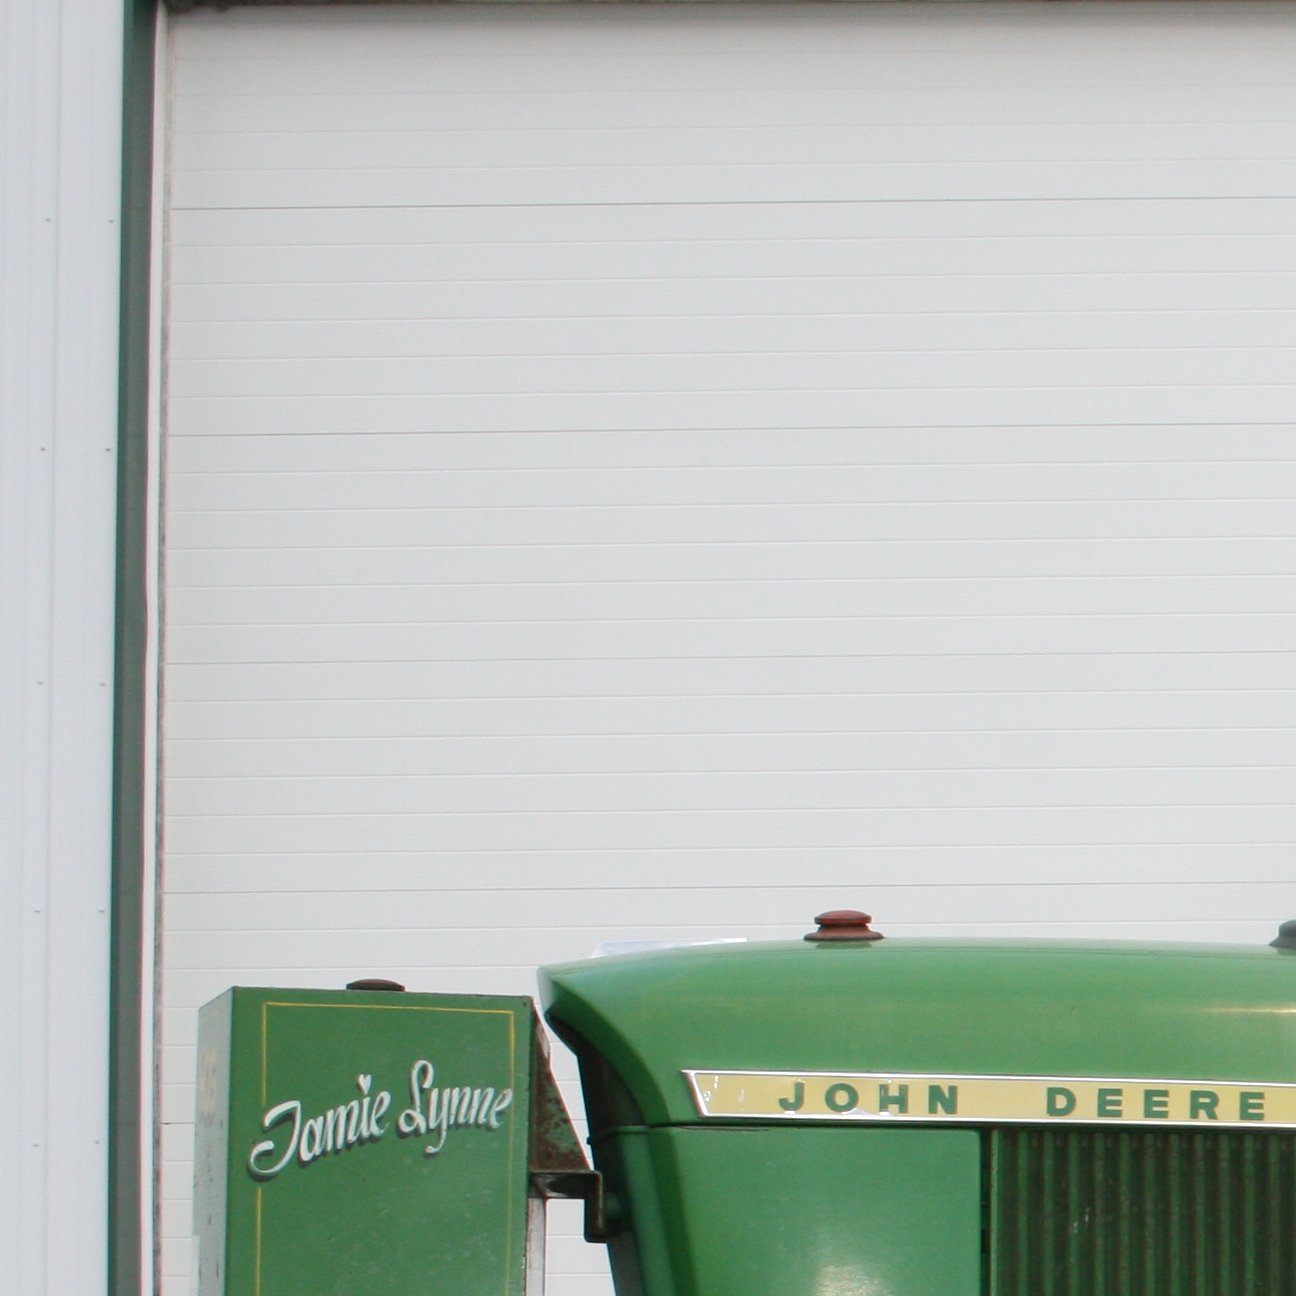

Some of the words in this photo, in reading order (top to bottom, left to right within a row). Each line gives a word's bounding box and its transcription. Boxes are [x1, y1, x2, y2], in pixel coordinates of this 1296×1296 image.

[250, 1074, 391, 1173] Jamie
[398, 1060, 513, 1153] Lynne
[778, 1081, 958, 1115] JOHN
[1047, 1086, 1266, 1121] DEERE
